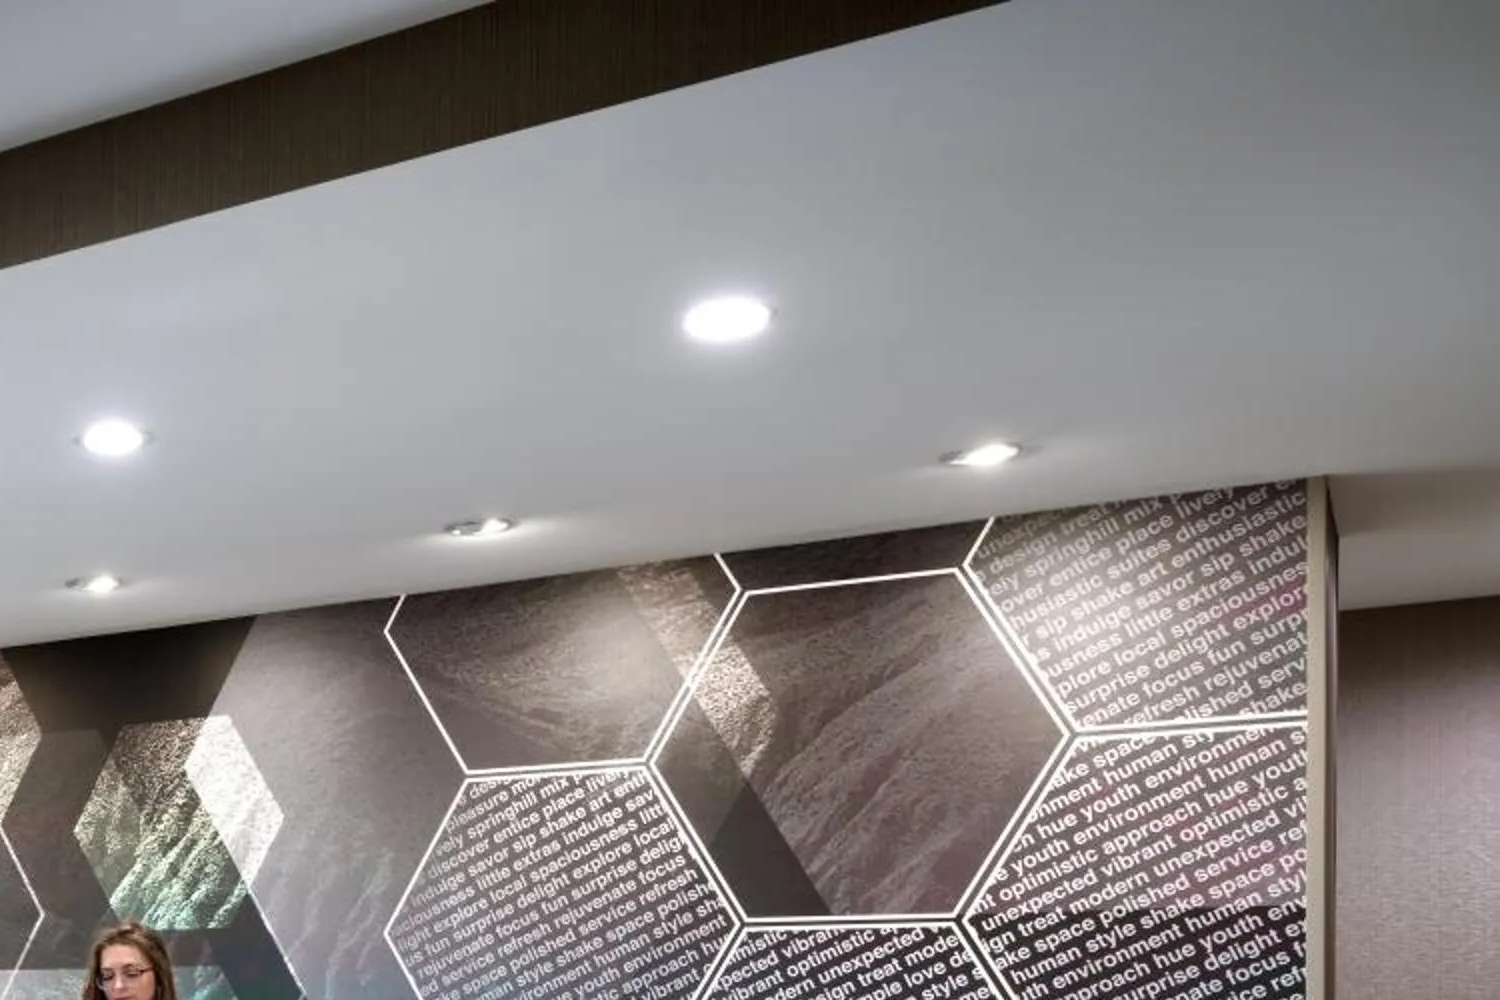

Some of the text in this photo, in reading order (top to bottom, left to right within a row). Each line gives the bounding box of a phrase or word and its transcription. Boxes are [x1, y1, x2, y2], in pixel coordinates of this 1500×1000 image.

[1024, 516, 1119, 577] springhill
[1122, 495, 1163, 525] mix
[1034, 491, 1305, 639] sip shake art enthusiastic
[1047, 545, 1112, 586] entice
[1115, 512, 1174, 554] place
[1105, 485, 1271, 579] suites discover
[1051, 514, 1308, 652] indulge savor sip shake
[1112, 560, 1310, 667] local spaciousnes
[1123, 569, 1245, 638] little extras
[1065, 583, 1310, 713] surprise delight explor
[1141, 639, 1246, 698] focus fun
[1202, 630, 1309, 691] rejuvenat
[466, 775, 570, 838] springhill mix
[1010, 737, 1287, 877] youth environment human
[1102, 742, 1178, 786] human
[425, 786, 585, 878] discover entice place
[466, 845, 511, 876] savor
[511, 832, 538, 852] sip
[538, 806, 586, 837] shake
[587, 790, 612, 811] art
[475, 806, 623, 890] little extras indulge
[997, 779, 1249, 901] optimistic approach hue
[1036, 779, 1141, 839] hue youth
[422, 816, 675, 956] fun surprise delight explore local
[432, 818, 638, 931] explore local spaciousness
[980, 784, 1289, 932] unexpected vibrant optimistic
[1016, 809, 1280, 938] treat modern unexpected
[1033, 839, 1275, 953] space polished service
[416, 858, 638, 979] rejuvenate focus fun surprise
[440, 854, 686, 985] service refresh rejuvenate focus
[461, 865, 698, 994] space polished service refresh
[515, 960, 554, 986] style
[555, 935, 604, 966] shake
[604, 910, 654, 941] space
[573, 964, 621, 1000] youth
[622, 913, 727, 972] environment
[592, 932, 651, 967] human
[652, 911, 694, 938] style
[785, 929, 875, 977] optimistic
[817, 925, 924, 984] unexpected
[1010, 862, 1276, 985] human style shake space
[1051, 868, 1309, 990] environment human styl
[1152, 942, 1196, 969] hue
[1198, 910, 1265, 954] youth
[1202, 928, 1283, 971] delight
[620, 947, 700, 994] approach
[856, 956, 903, 987] treat
[903, 961, 947, 987] love
[1224, 950, 1291, 986] focus
